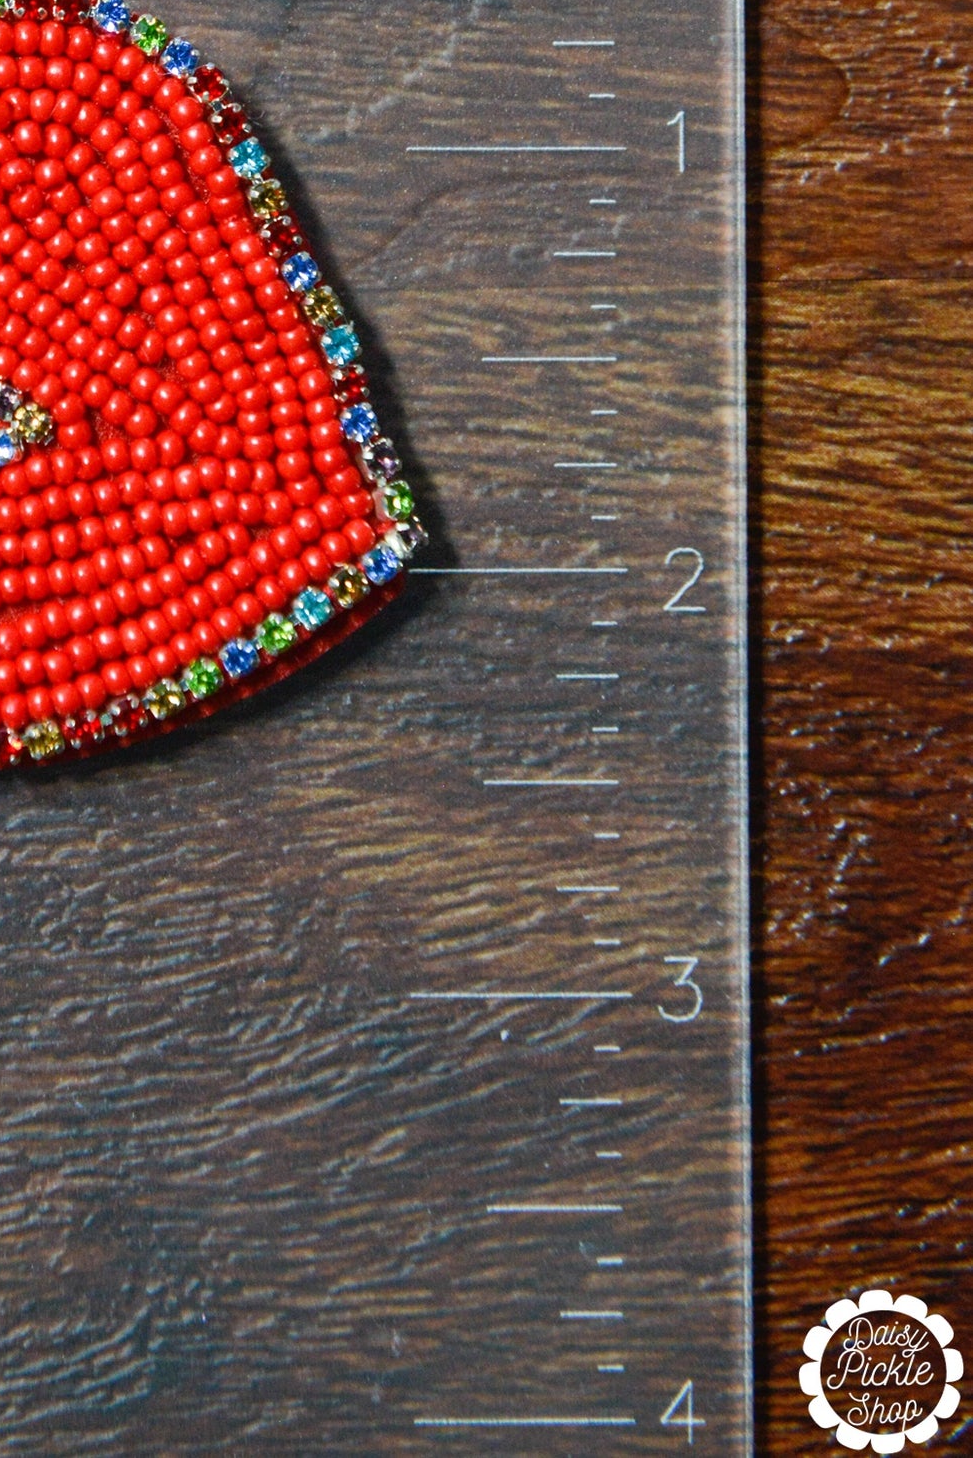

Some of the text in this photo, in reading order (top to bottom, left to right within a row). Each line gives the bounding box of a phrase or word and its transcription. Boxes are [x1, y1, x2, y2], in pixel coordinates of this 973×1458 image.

[666, 110, 685, 173] 1
[662, 547, 706, 611] 2
[657, 956, 703, 1023] 3
[660, 1379, 706, 1446] 4
